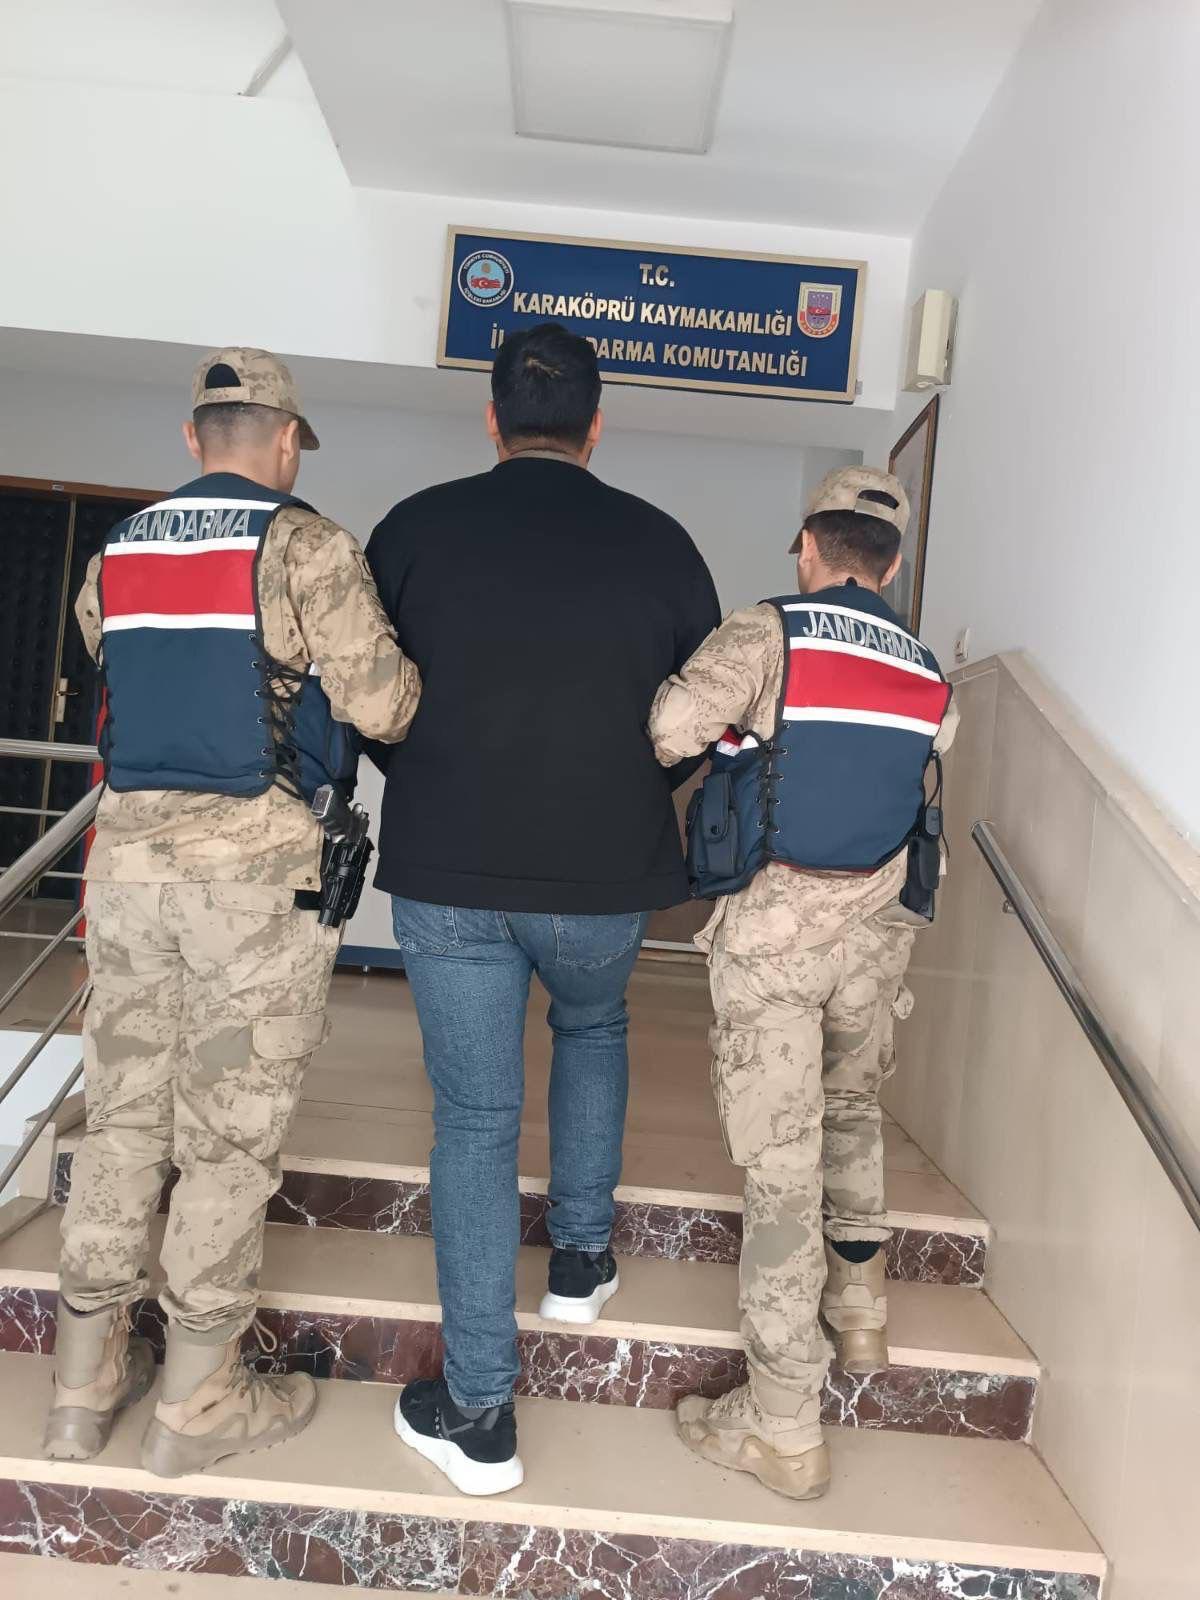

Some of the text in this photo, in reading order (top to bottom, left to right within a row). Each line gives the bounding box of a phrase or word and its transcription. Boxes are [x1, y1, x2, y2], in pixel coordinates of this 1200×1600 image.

[640, 263, 675, 287] T.C.
[513, 292, 635, 322] KARAKÖPRÜ
[640, 302, 792, 336] KAYMAKAMLIĞI
[585, 336, 656, 362] ARMA
[663, 343, 808, 377] KOMUTANLIĞI
[119, 508, 250, 542] JANDARMA
[802, 611, 926, 667] JANDARMA
